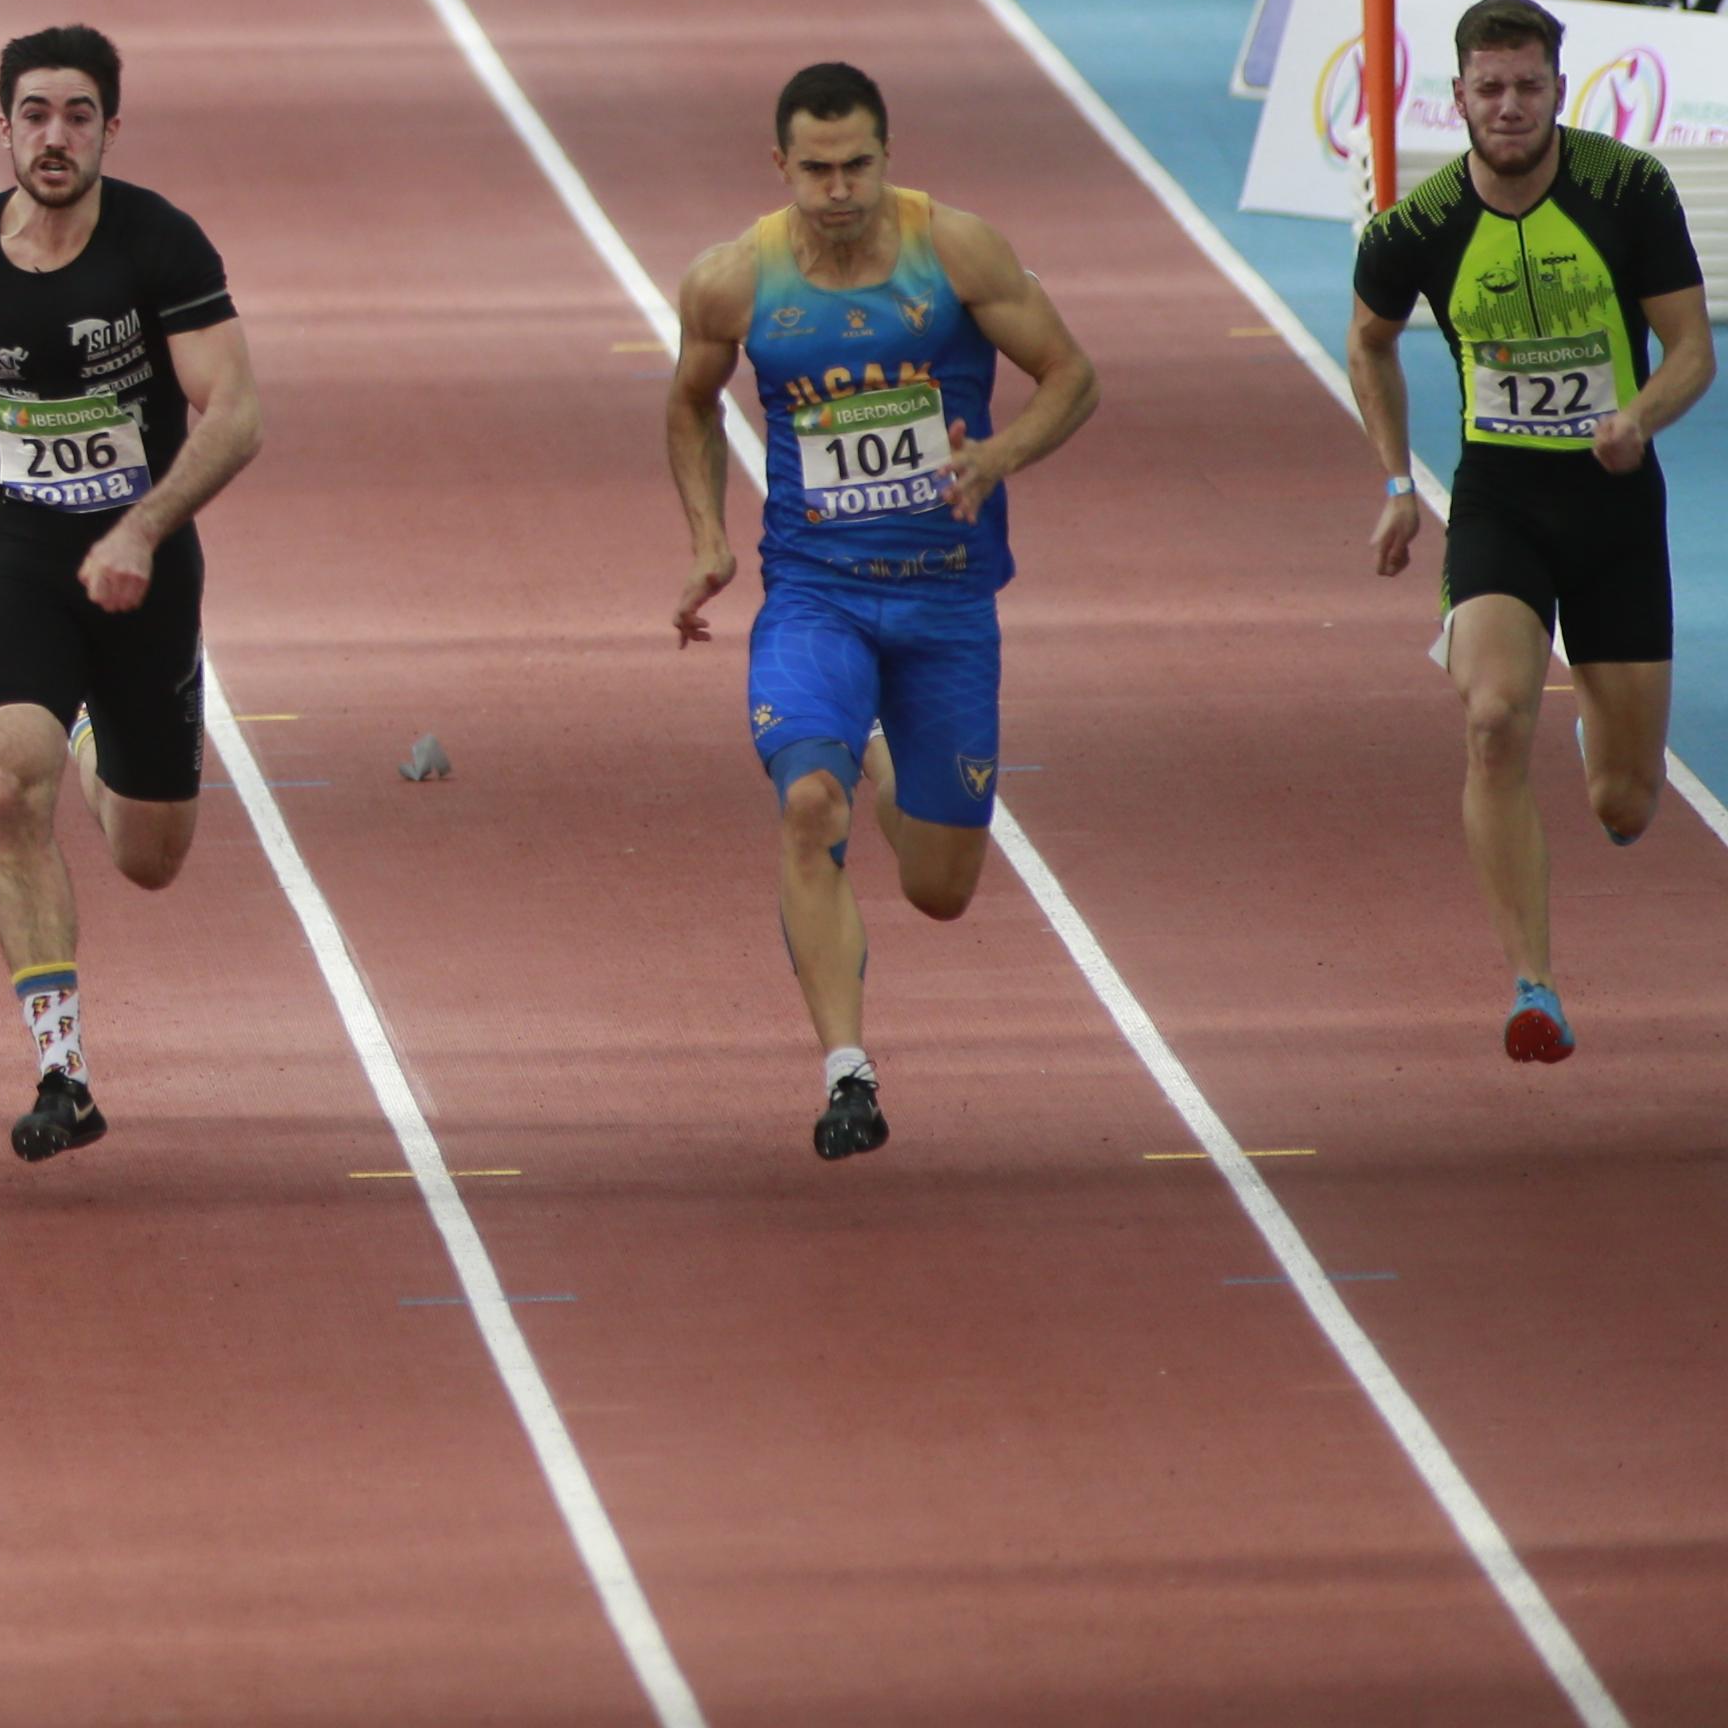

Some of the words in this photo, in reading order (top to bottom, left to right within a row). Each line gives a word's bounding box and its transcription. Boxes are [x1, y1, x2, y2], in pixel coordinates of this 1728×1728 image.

[1511, 343, 1605, 365] IBERDROLA
[30, 404, 124, 428] IBERDROLA
[836, 395, 931, 425] IBERDROLA
[1498, 372, 1593, 417] 122
[22, 431, 118, 478] 206
[825, 427, 924, 481] 104
[820, 476, 937, 519] Joma
